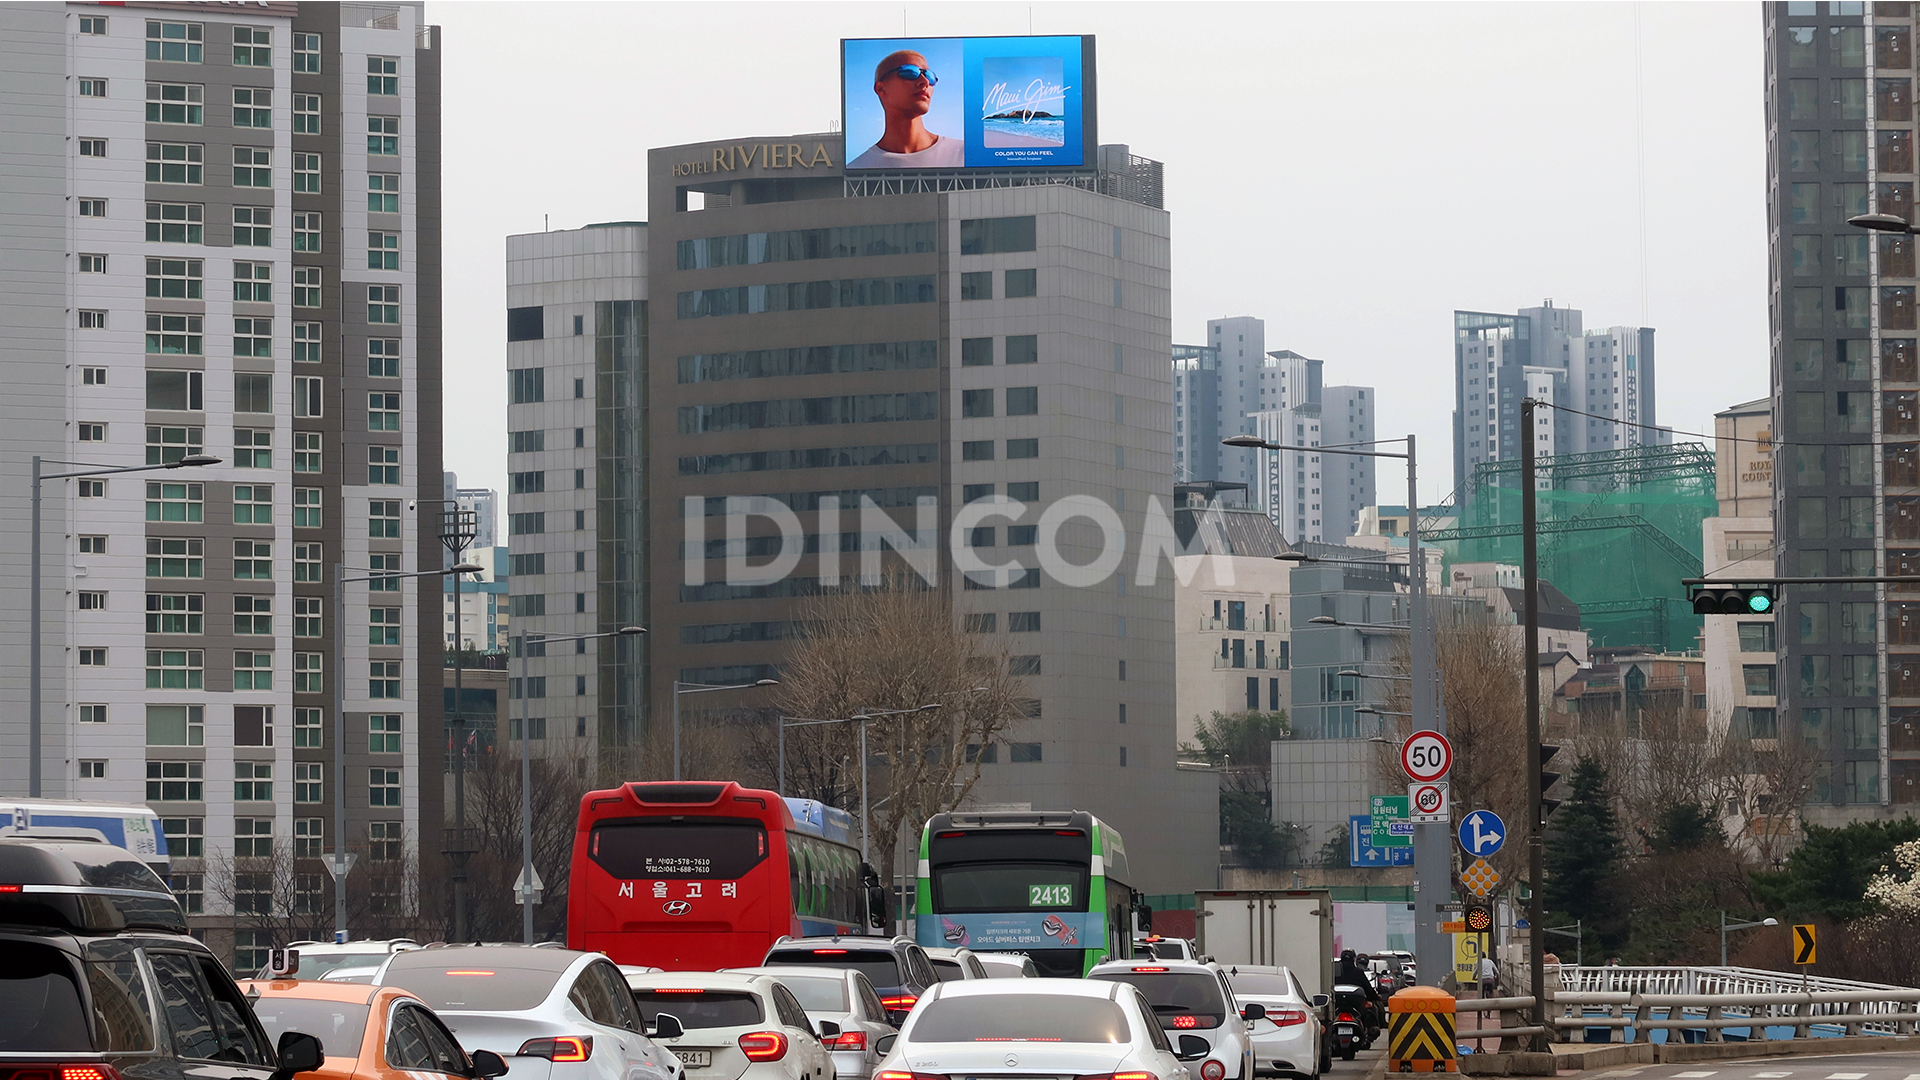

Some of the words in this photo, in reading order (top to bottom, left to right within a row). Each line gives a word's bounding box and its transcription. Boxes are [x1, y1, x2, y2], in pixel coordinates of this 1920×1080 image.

[982, 82, 1022, 111] Maui
[1022, 78, 1072, 124] Jim
[672, 161, 709, 177] HOTEL
[713, 142, 834, 172] RIVIERA
[1270, 461, 1280, 528] RAEMIA
[1412, 745, 1442, 768] 50
[1420, 794, 1436, 806] 60
[1032, 887, 1070, 905] 2413
